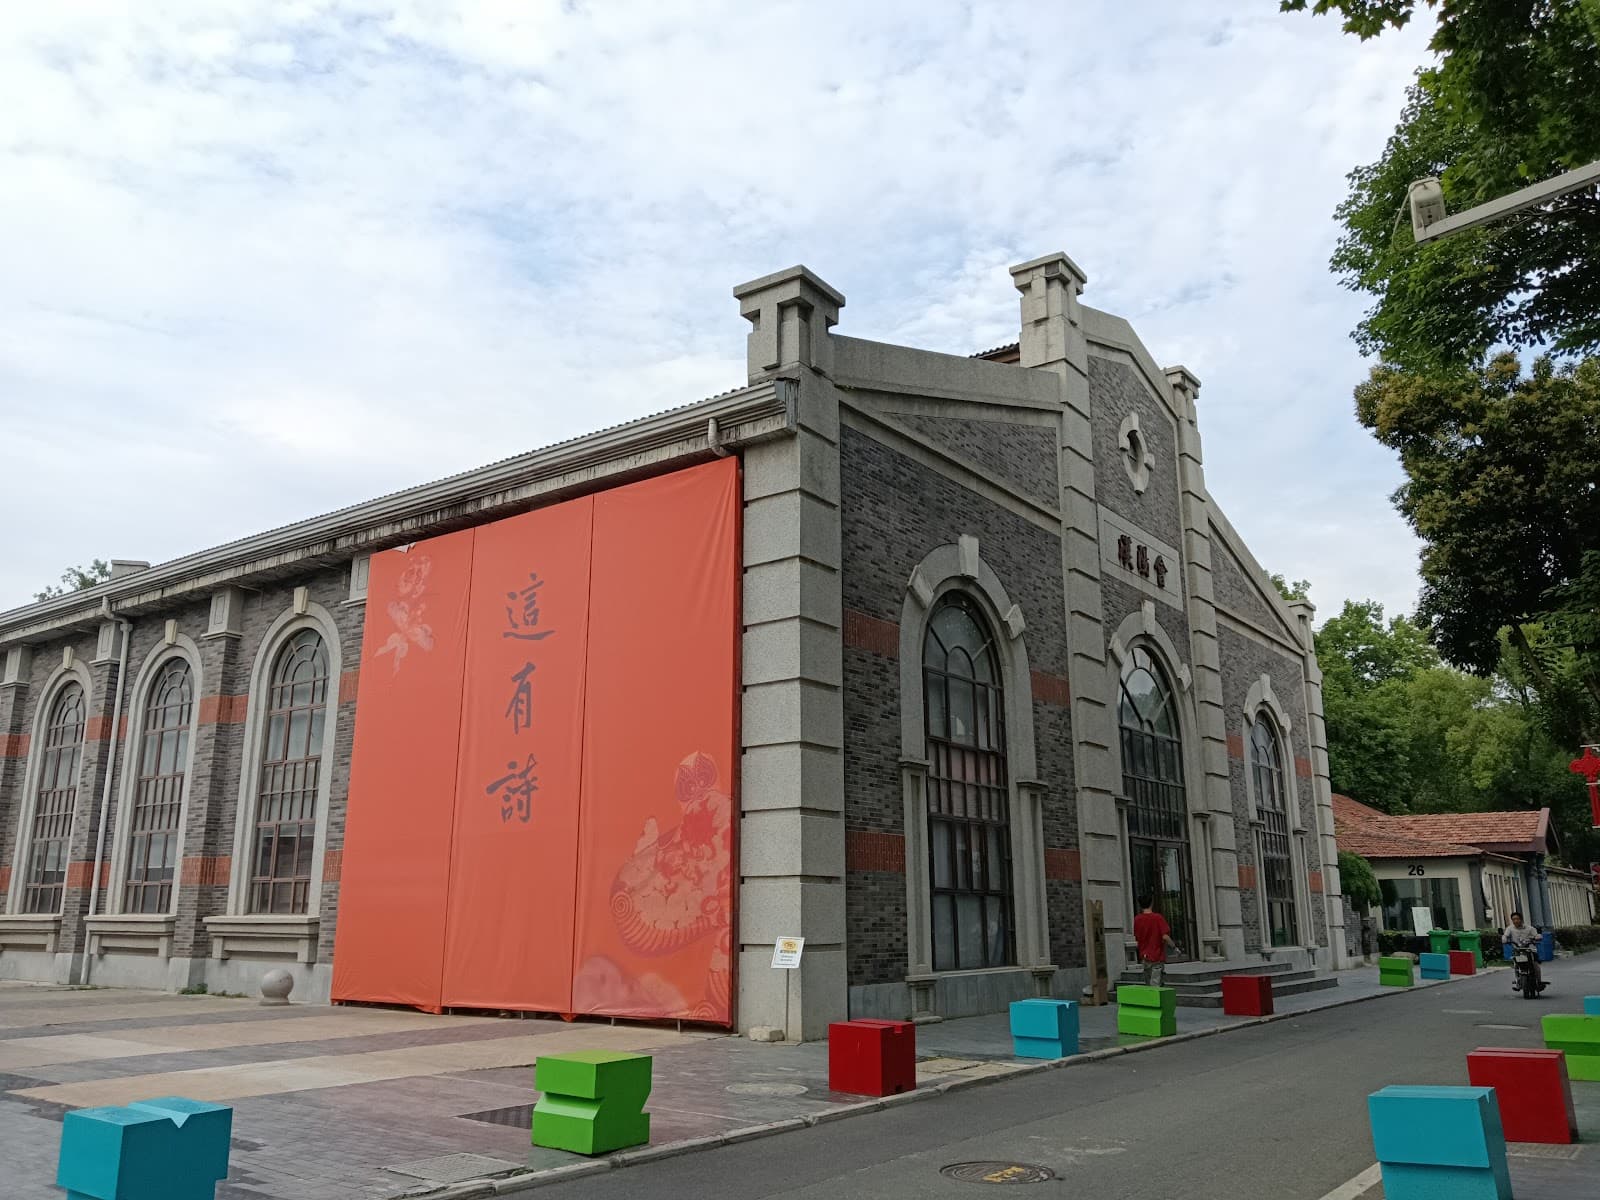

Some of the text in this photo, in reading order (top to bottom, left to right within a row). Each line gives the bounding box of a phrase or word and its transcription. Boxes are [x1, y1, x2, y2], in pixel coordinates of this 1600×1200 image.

[486, 572, 556, 824] 這有詩
[1408, 864, 1425, 876] 26
